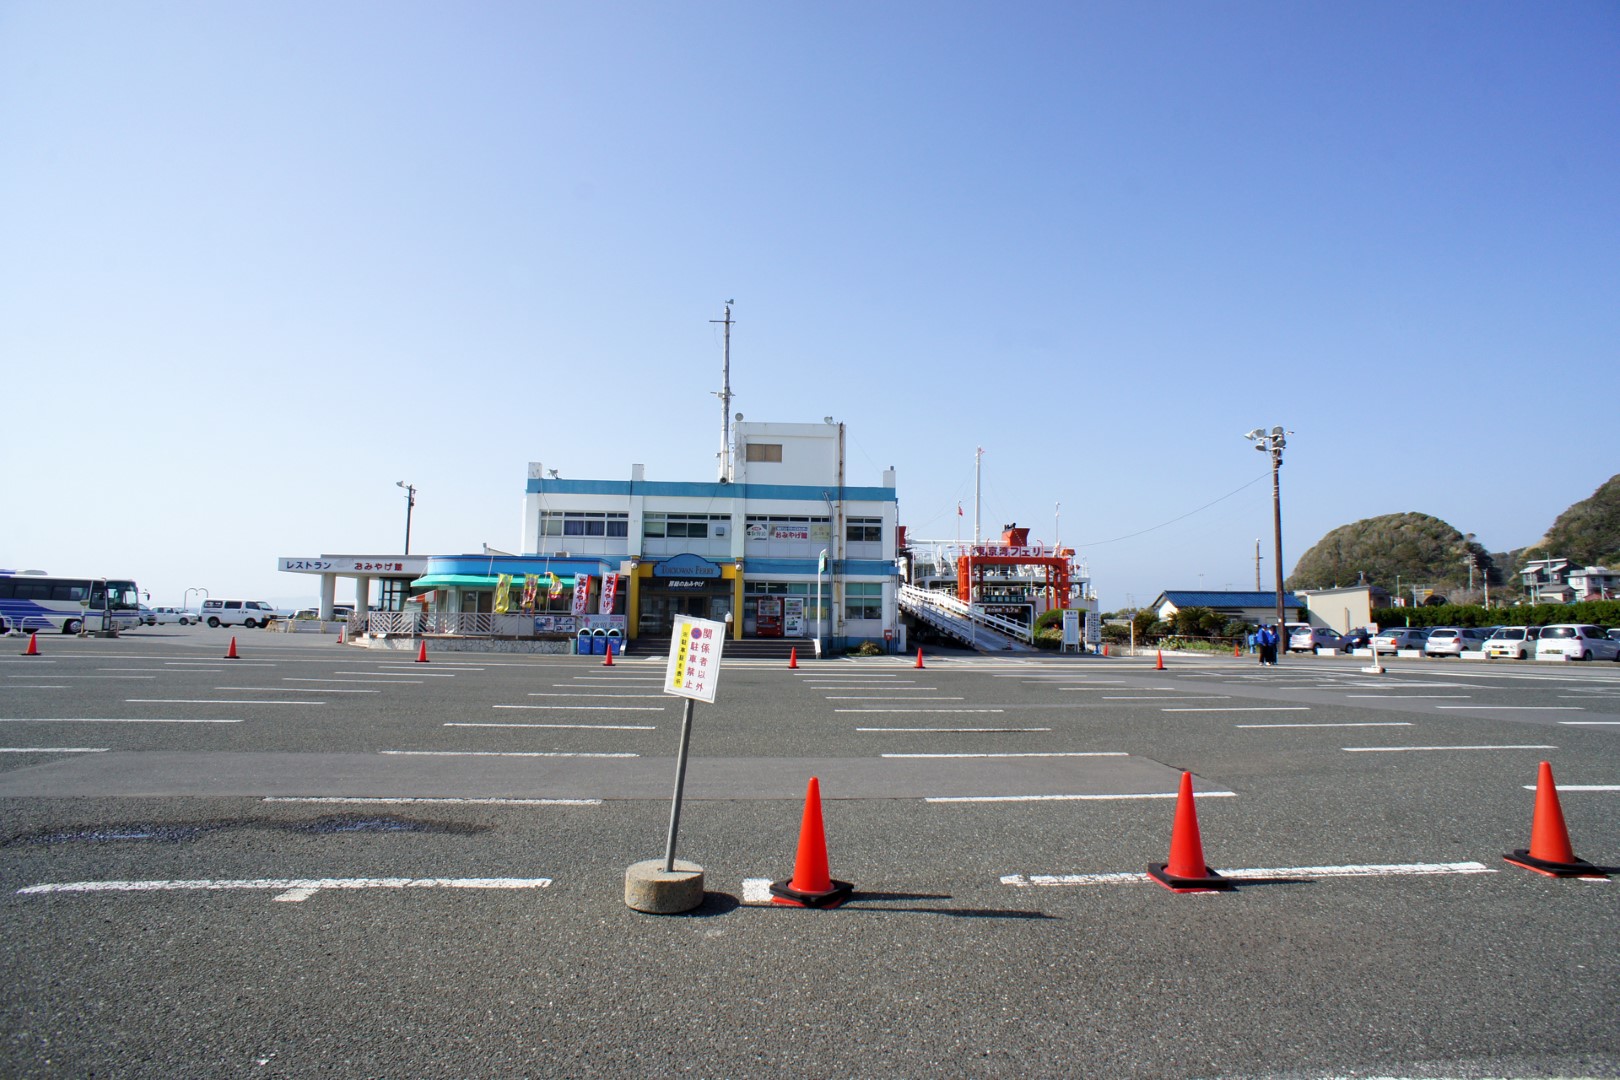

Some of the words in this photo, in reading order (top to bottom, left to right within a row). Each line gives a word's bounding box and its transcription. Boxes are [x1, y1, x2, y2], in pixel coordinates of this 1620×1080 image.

[976, 546, 1053, 557] 東京湾フェリー
[286, 561, 332, 570] レストラン
[354, 562, 403, 571] おみやげ館
[684, 641, 699, 689] 駐車禁止
[695, 628, 713, 692] 関係者以外
